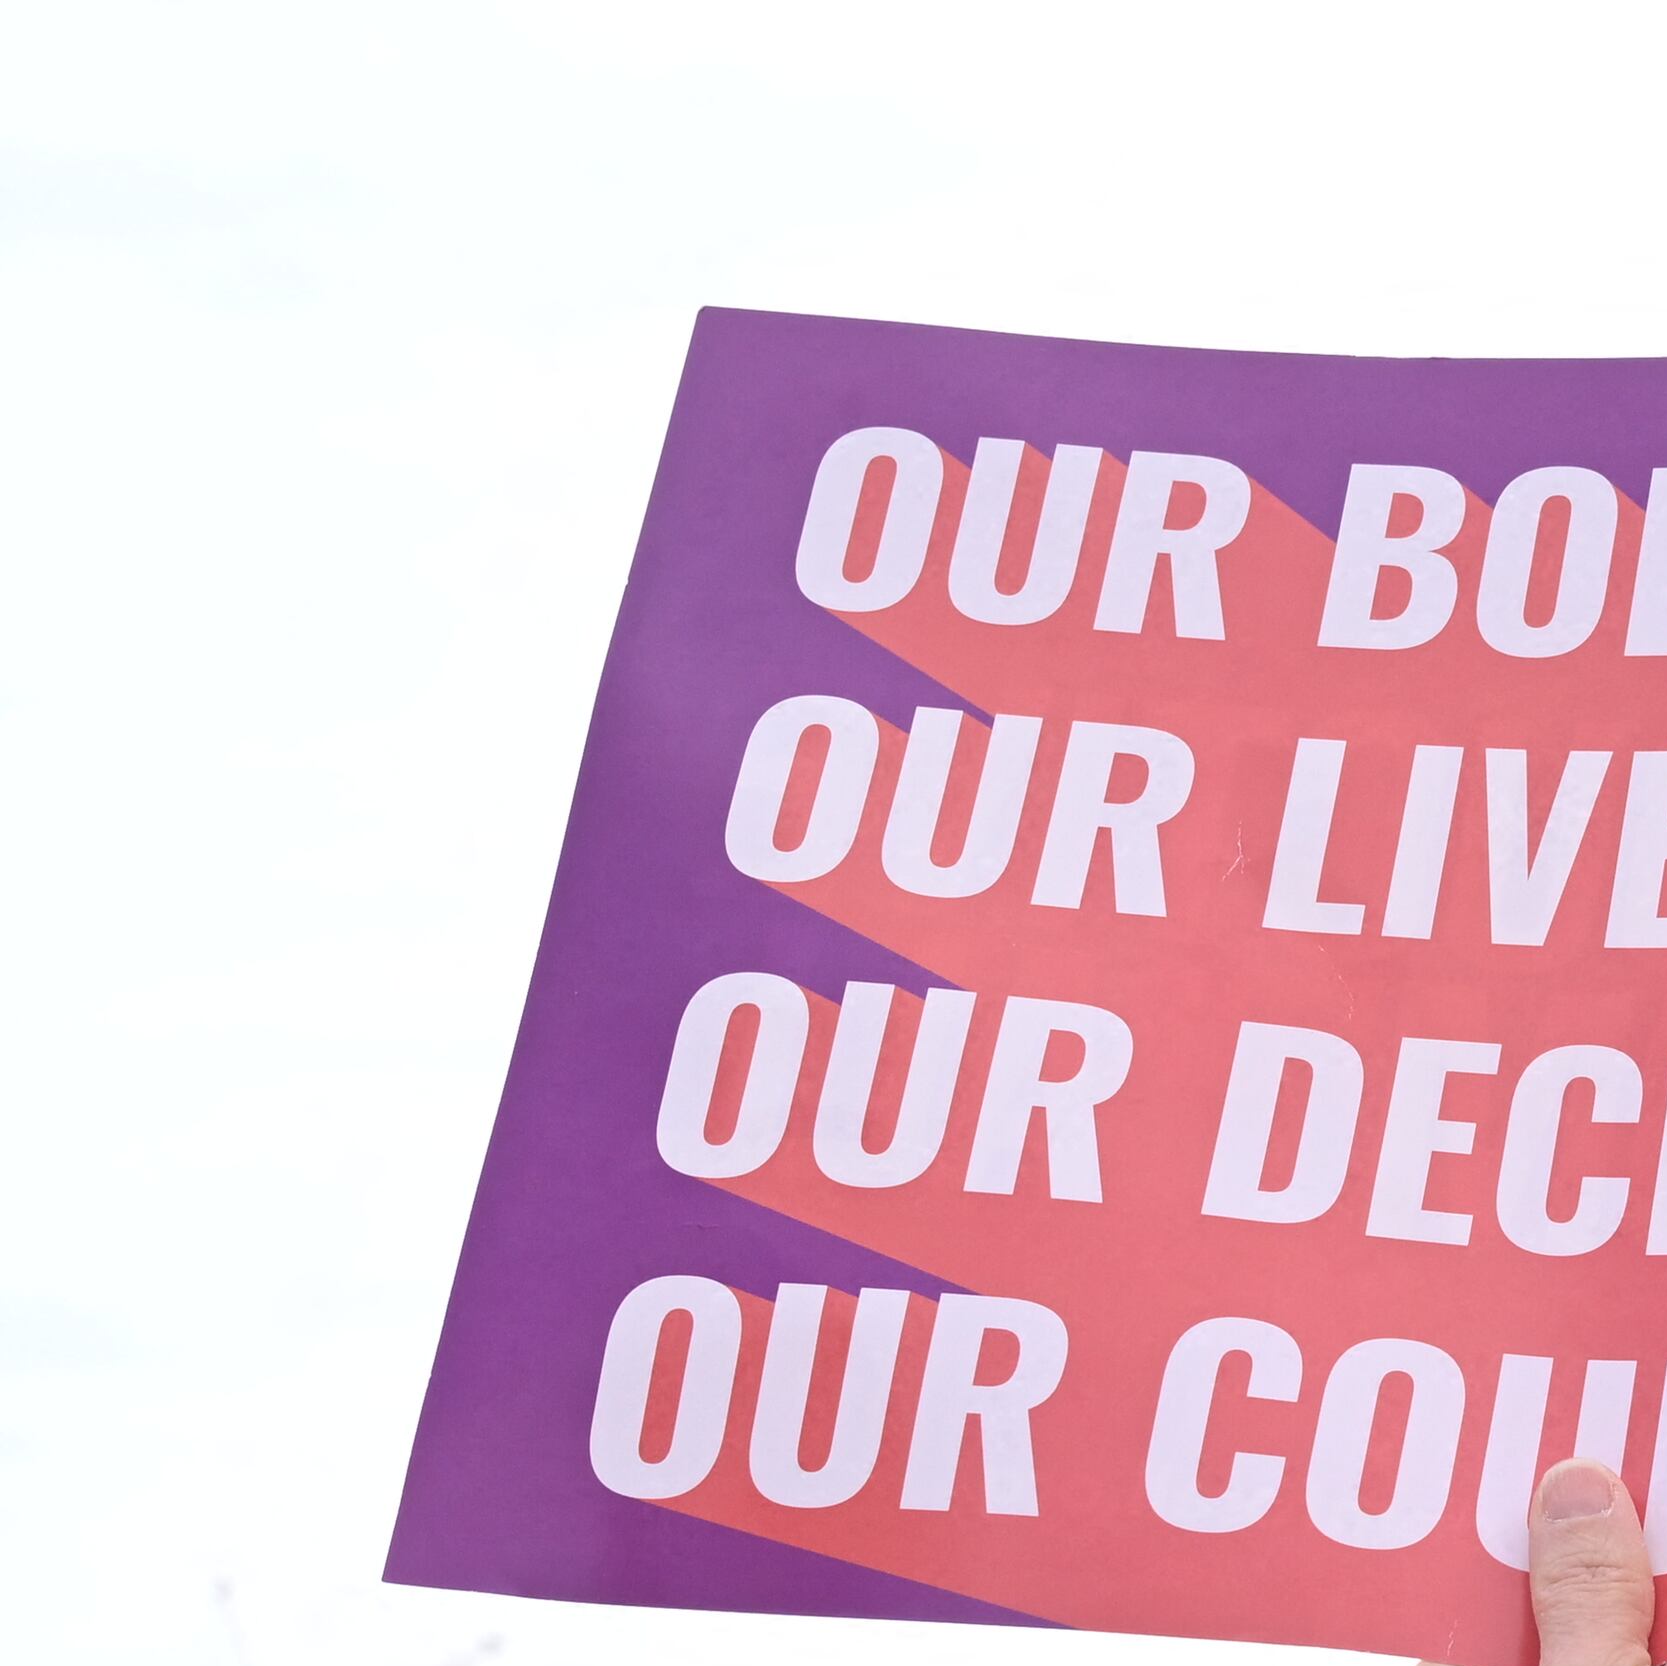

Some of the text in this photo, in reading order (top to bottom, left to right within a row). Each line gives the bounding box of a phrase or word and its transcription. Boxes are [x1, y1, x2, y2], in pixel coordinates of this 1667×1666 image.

[796, 427, 1251, 640] OUR
[725, 695, 1195, 917] OUR
[657, 972, 1133, 1203] OUR
[590, 1275, 1068, 1516] OUR
